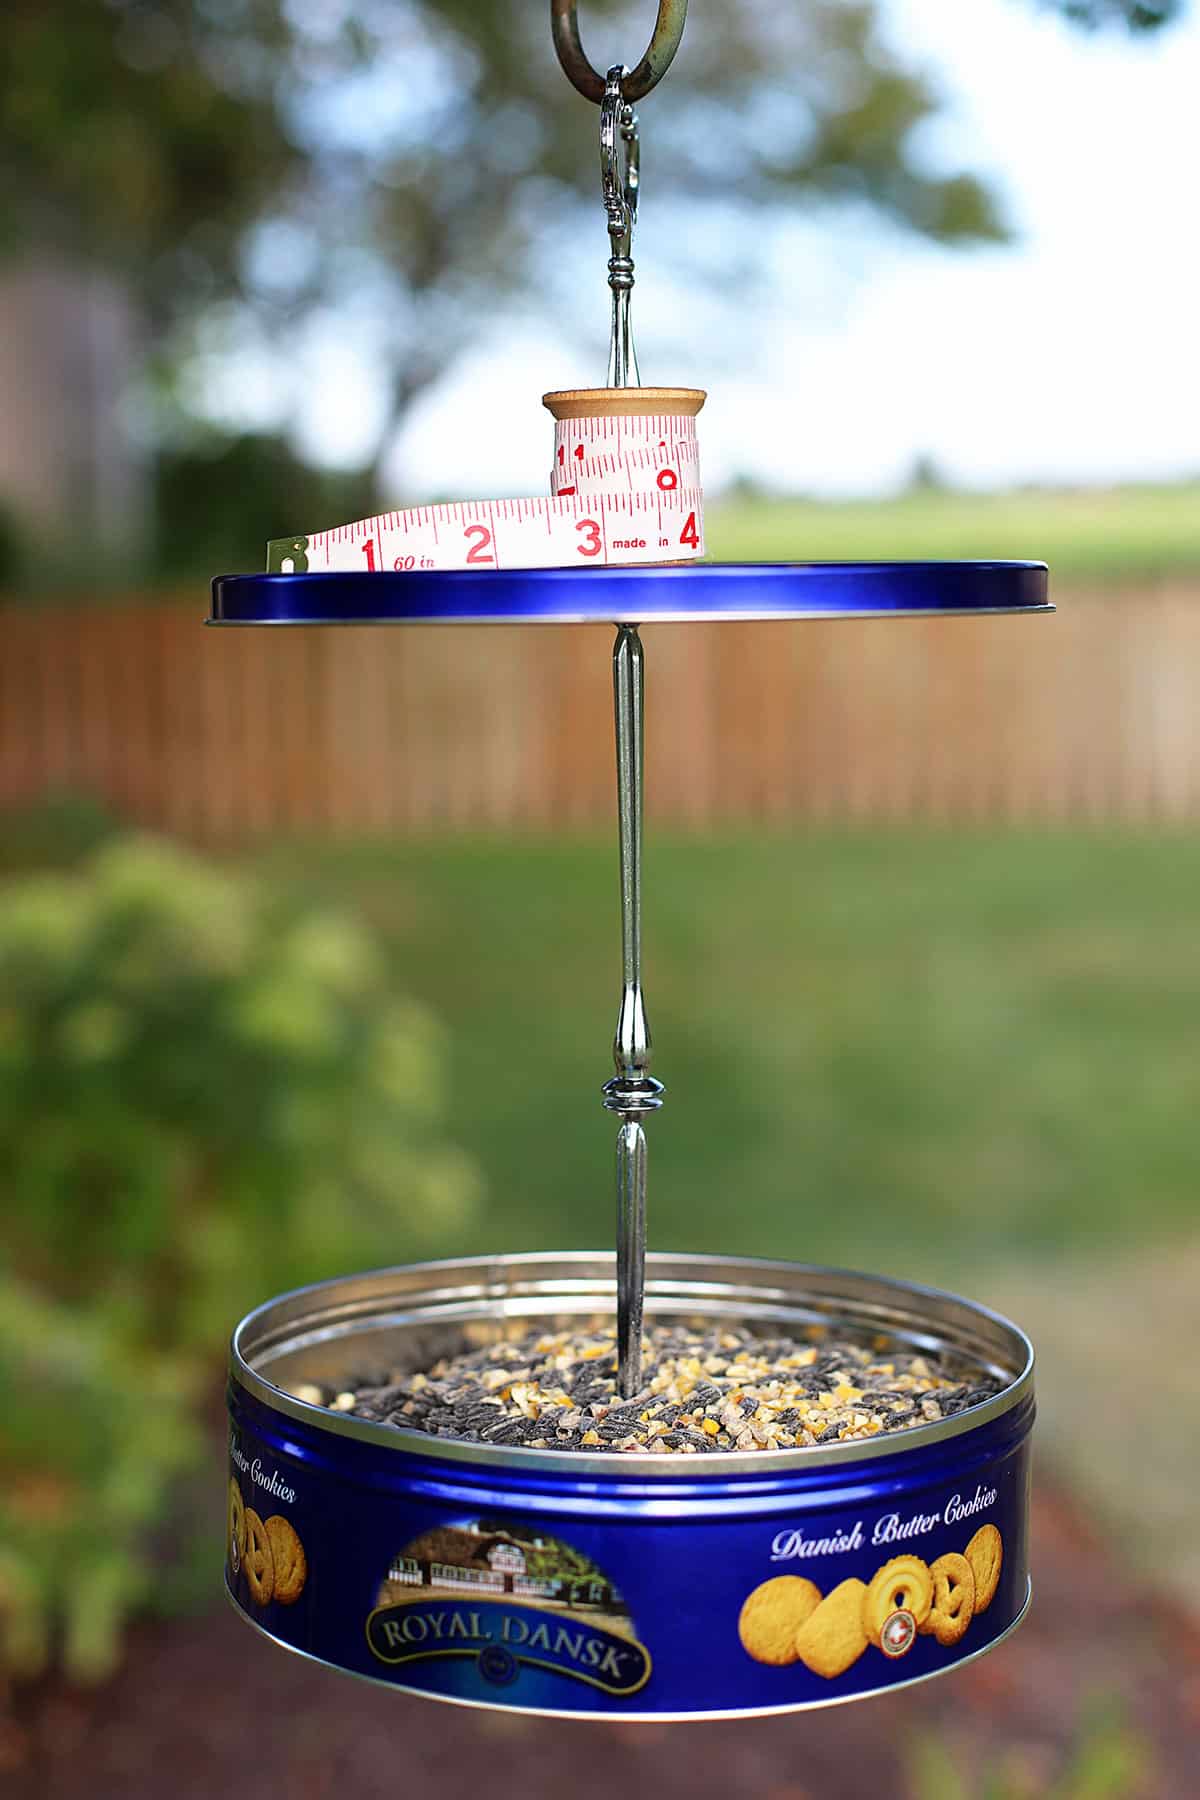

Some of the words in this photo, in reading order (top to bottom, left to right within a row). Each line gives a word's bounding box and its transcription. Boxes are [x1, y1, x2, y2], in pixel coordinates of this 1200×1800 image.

[362, 539, 375, 573] 1
[394, 555, 415, 572] 60
[420, 555, 435, 568] in
[463, 525, 494, 564] 2
[575, 519, 602, 557] 3
[613, 537, 646, 550] made
[659, 536, 669, 548] in
[679, 511, 700, 550] 4
[251, 1458, 296, 1503] Cookies
[770, 1520, 865, 1561] Danish
[871, 1512, 941, 1546] Butter
[943, 1485, 998, 1525] Cookies
[383, 1611, 491, 1648] ROYAL
[502, 1614, 629, 1679] DANSK
